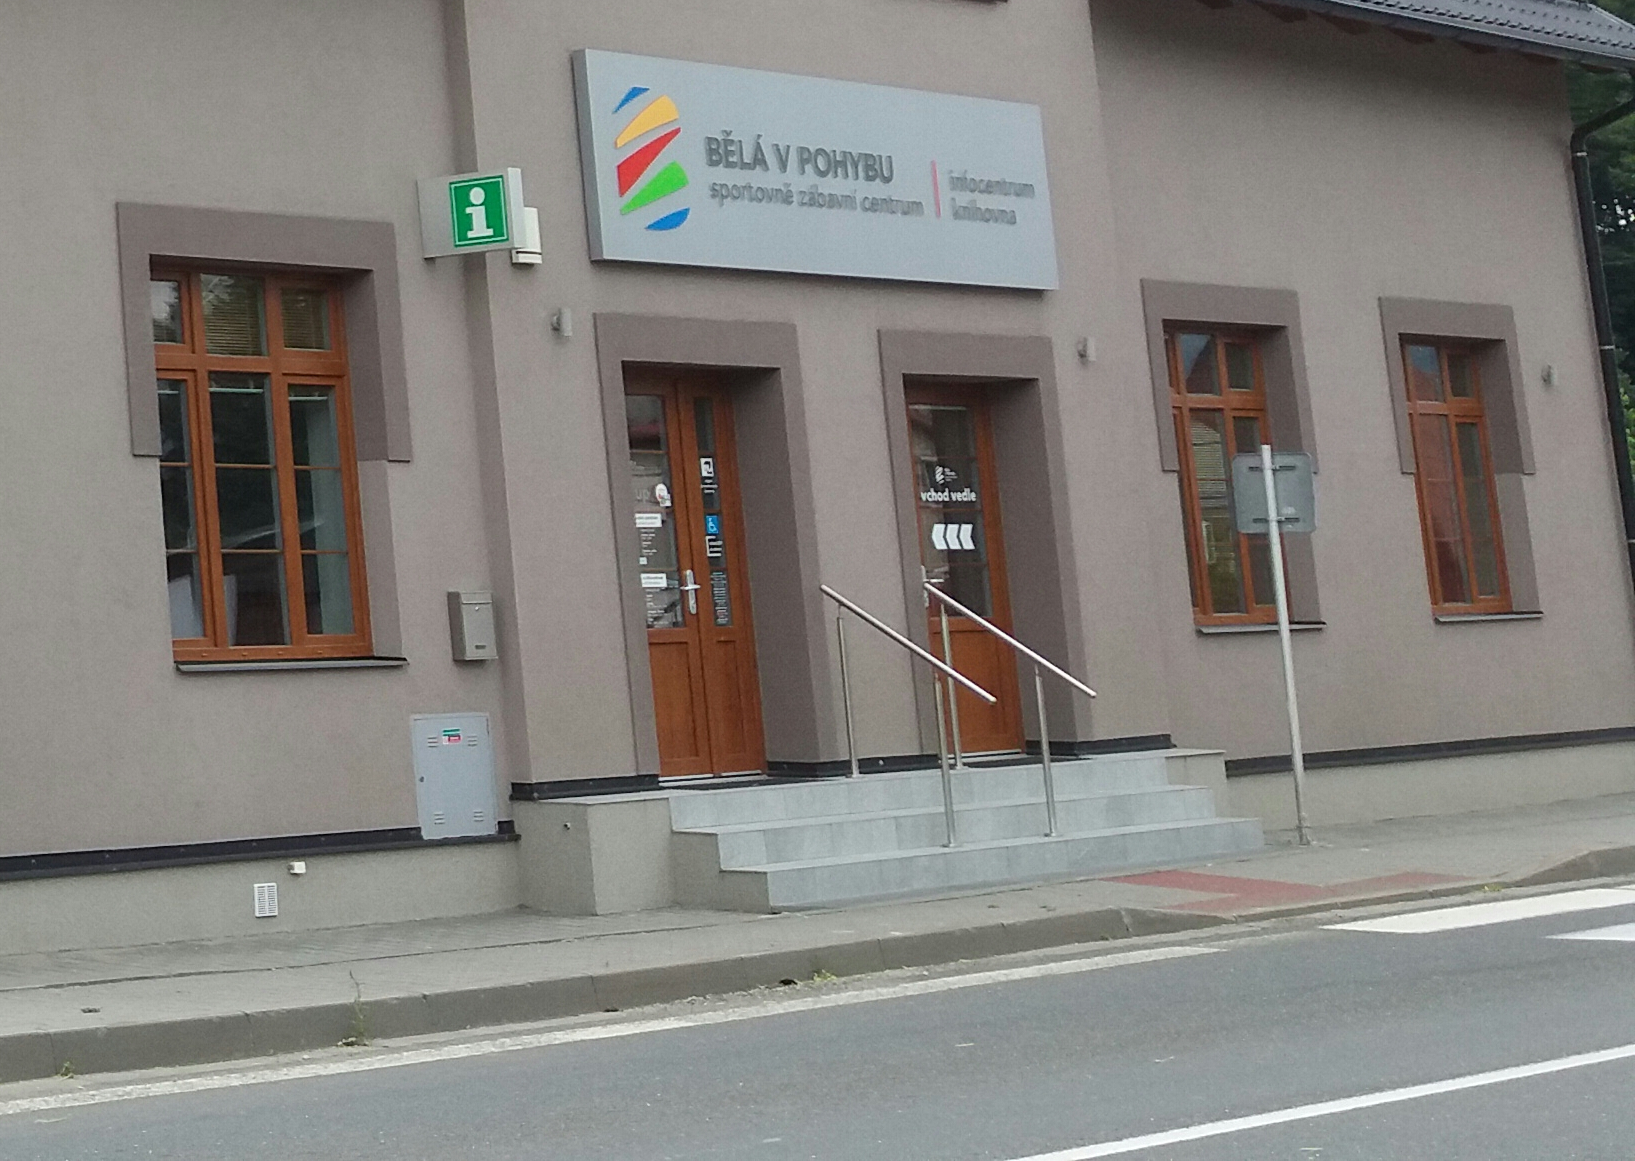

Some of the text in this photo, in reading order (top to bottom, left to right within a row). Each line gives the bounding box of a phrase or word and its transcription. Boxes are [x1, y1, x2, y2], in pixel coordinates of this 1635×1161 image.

[705, 130, 894, 184] BĚLÁ V POHYBU
[710, 182, 924, 217] sportovně zábavní centrum
[920, 487, 977, 502] vchod vedle
